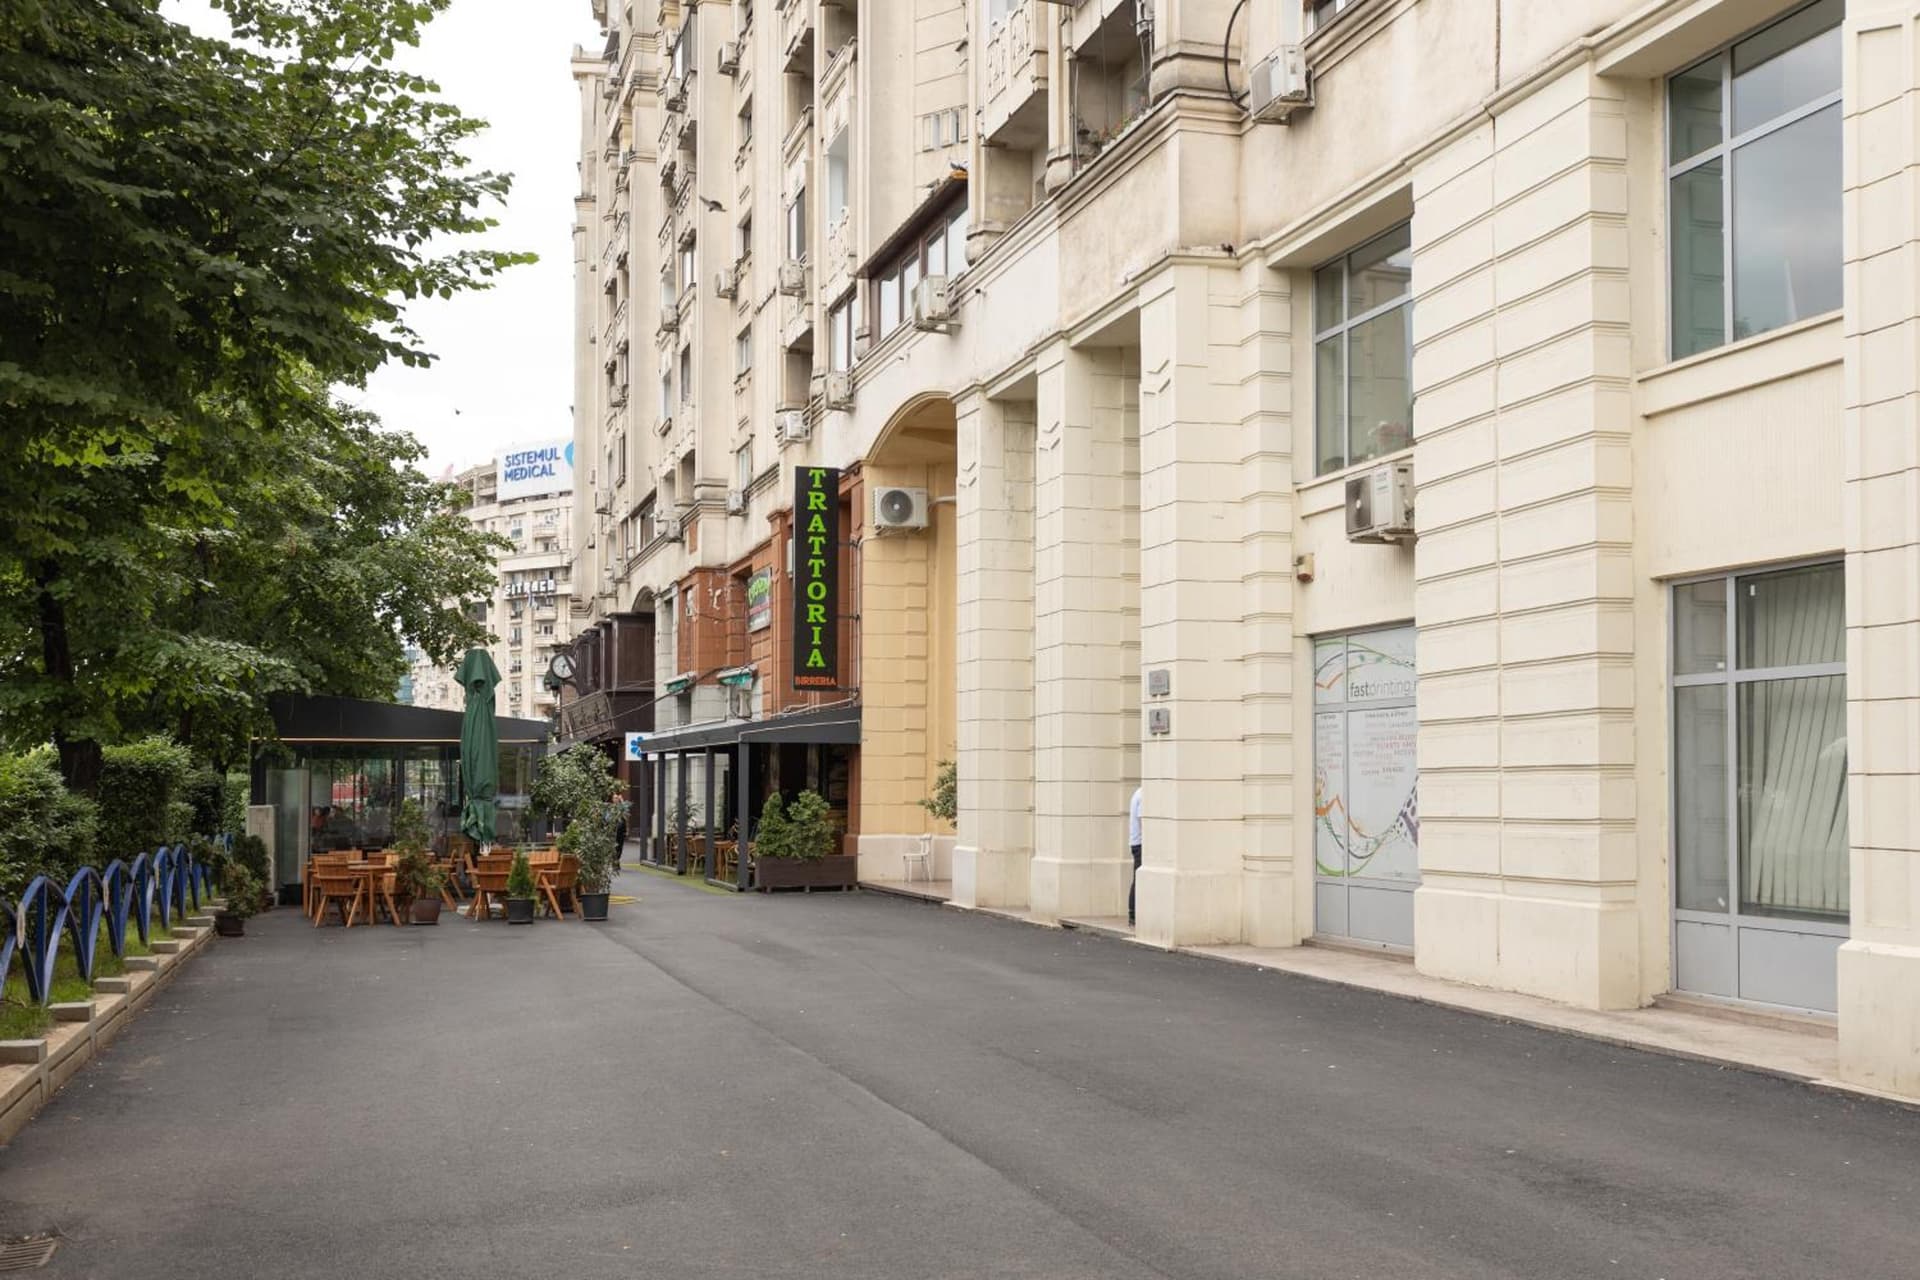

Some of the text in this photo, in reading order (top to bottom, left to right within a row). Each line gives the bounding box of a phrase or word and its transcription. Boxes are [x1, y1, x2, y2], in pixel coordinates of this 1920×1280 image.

[505, 447, 560, 467] SISTEMUL
[504, 464, 555, 482] MEDICAL
[806, 469, 827, 667] TRATTORIA
